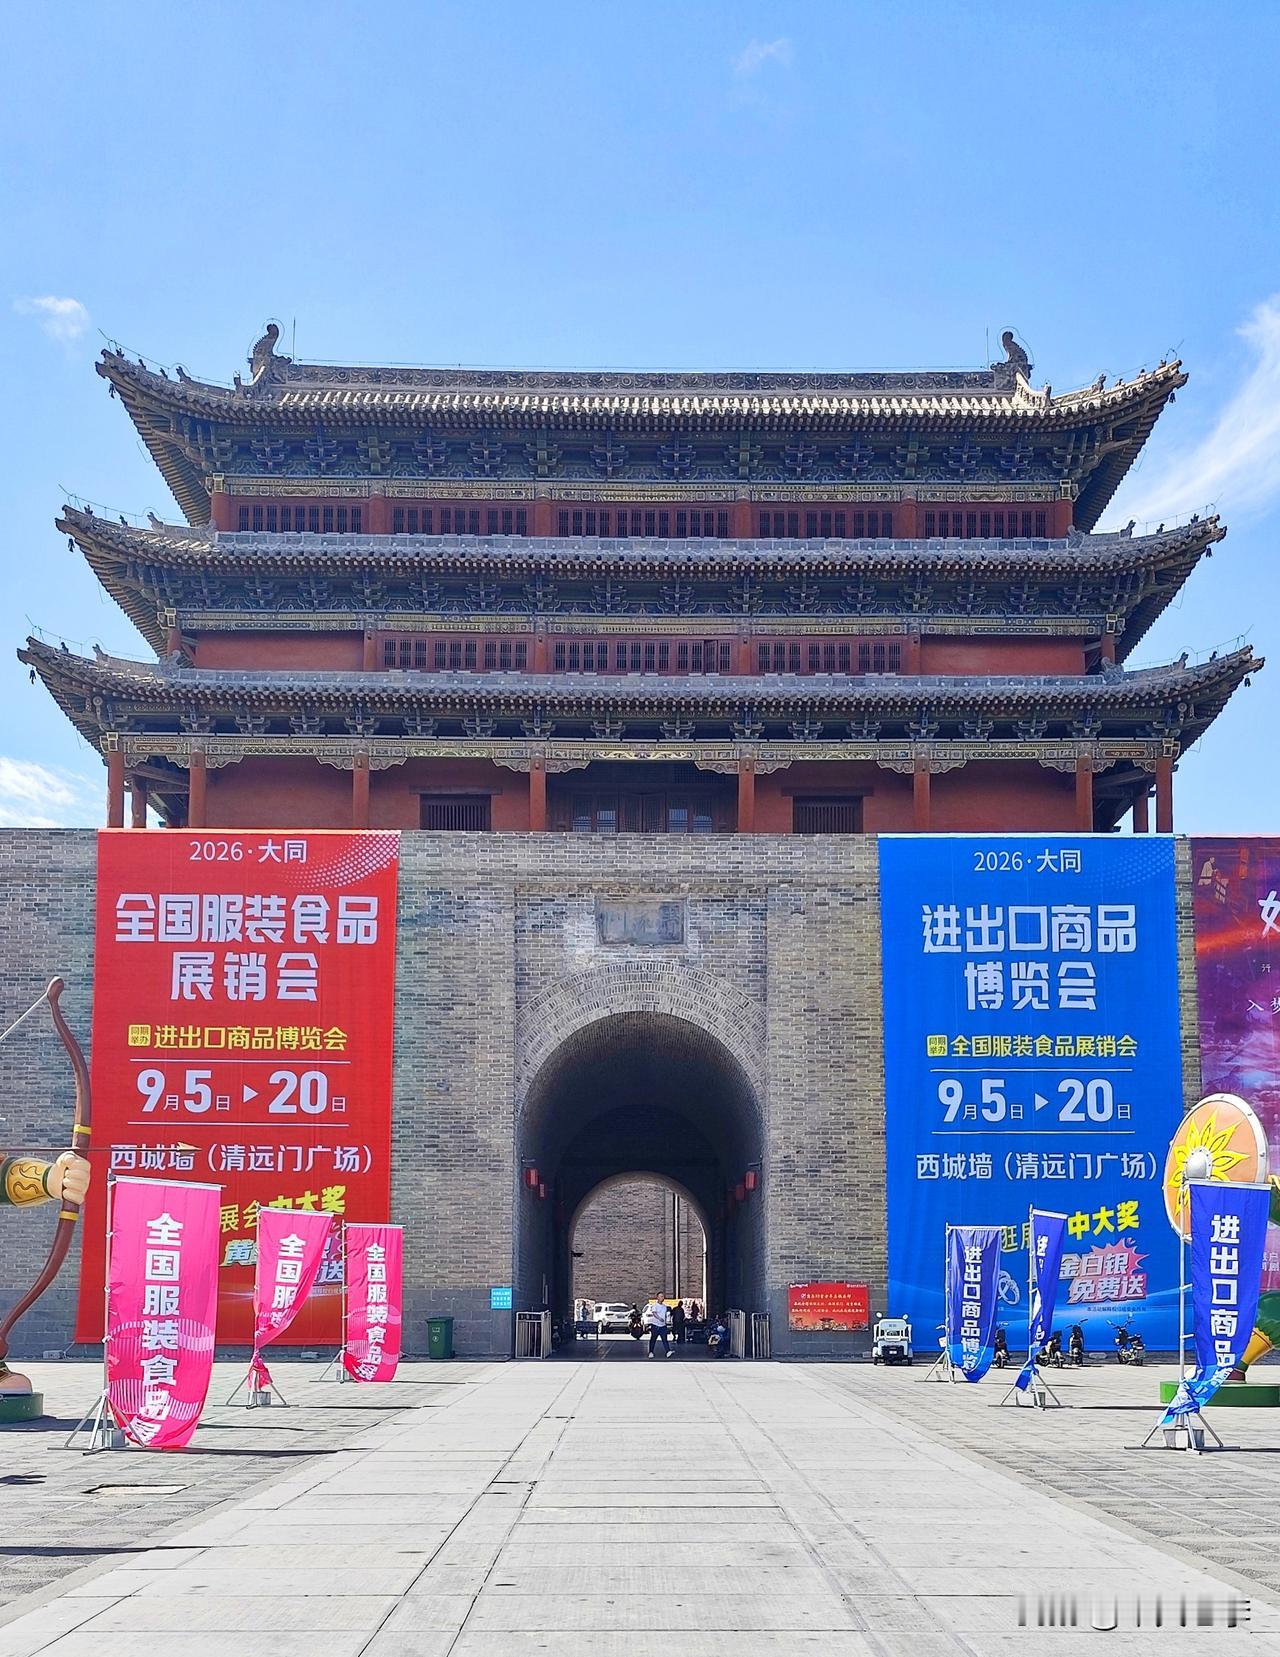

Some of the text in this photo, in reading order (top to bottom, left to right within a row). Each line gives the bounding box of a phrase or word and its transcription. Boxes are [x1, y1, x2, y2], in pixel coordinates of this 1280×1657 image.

[188, 838, 308, 864] 2026·大同
[972, 848, 1081, 873] 2026·大同
[115, 892, 379, 945] 全国服装食品
[921, 903, 1137, 953] 进出口商品
[170, 950, 319, 1002] 展销会
[963, 960, 1097, 1011] 博览会
[154, 1024, 348, 1051] 进出口商品博览会
[950, 1034, 1138, 1058] 全国服装食品展销会
[1067, 1200, 1140, 1241] 中大奖
